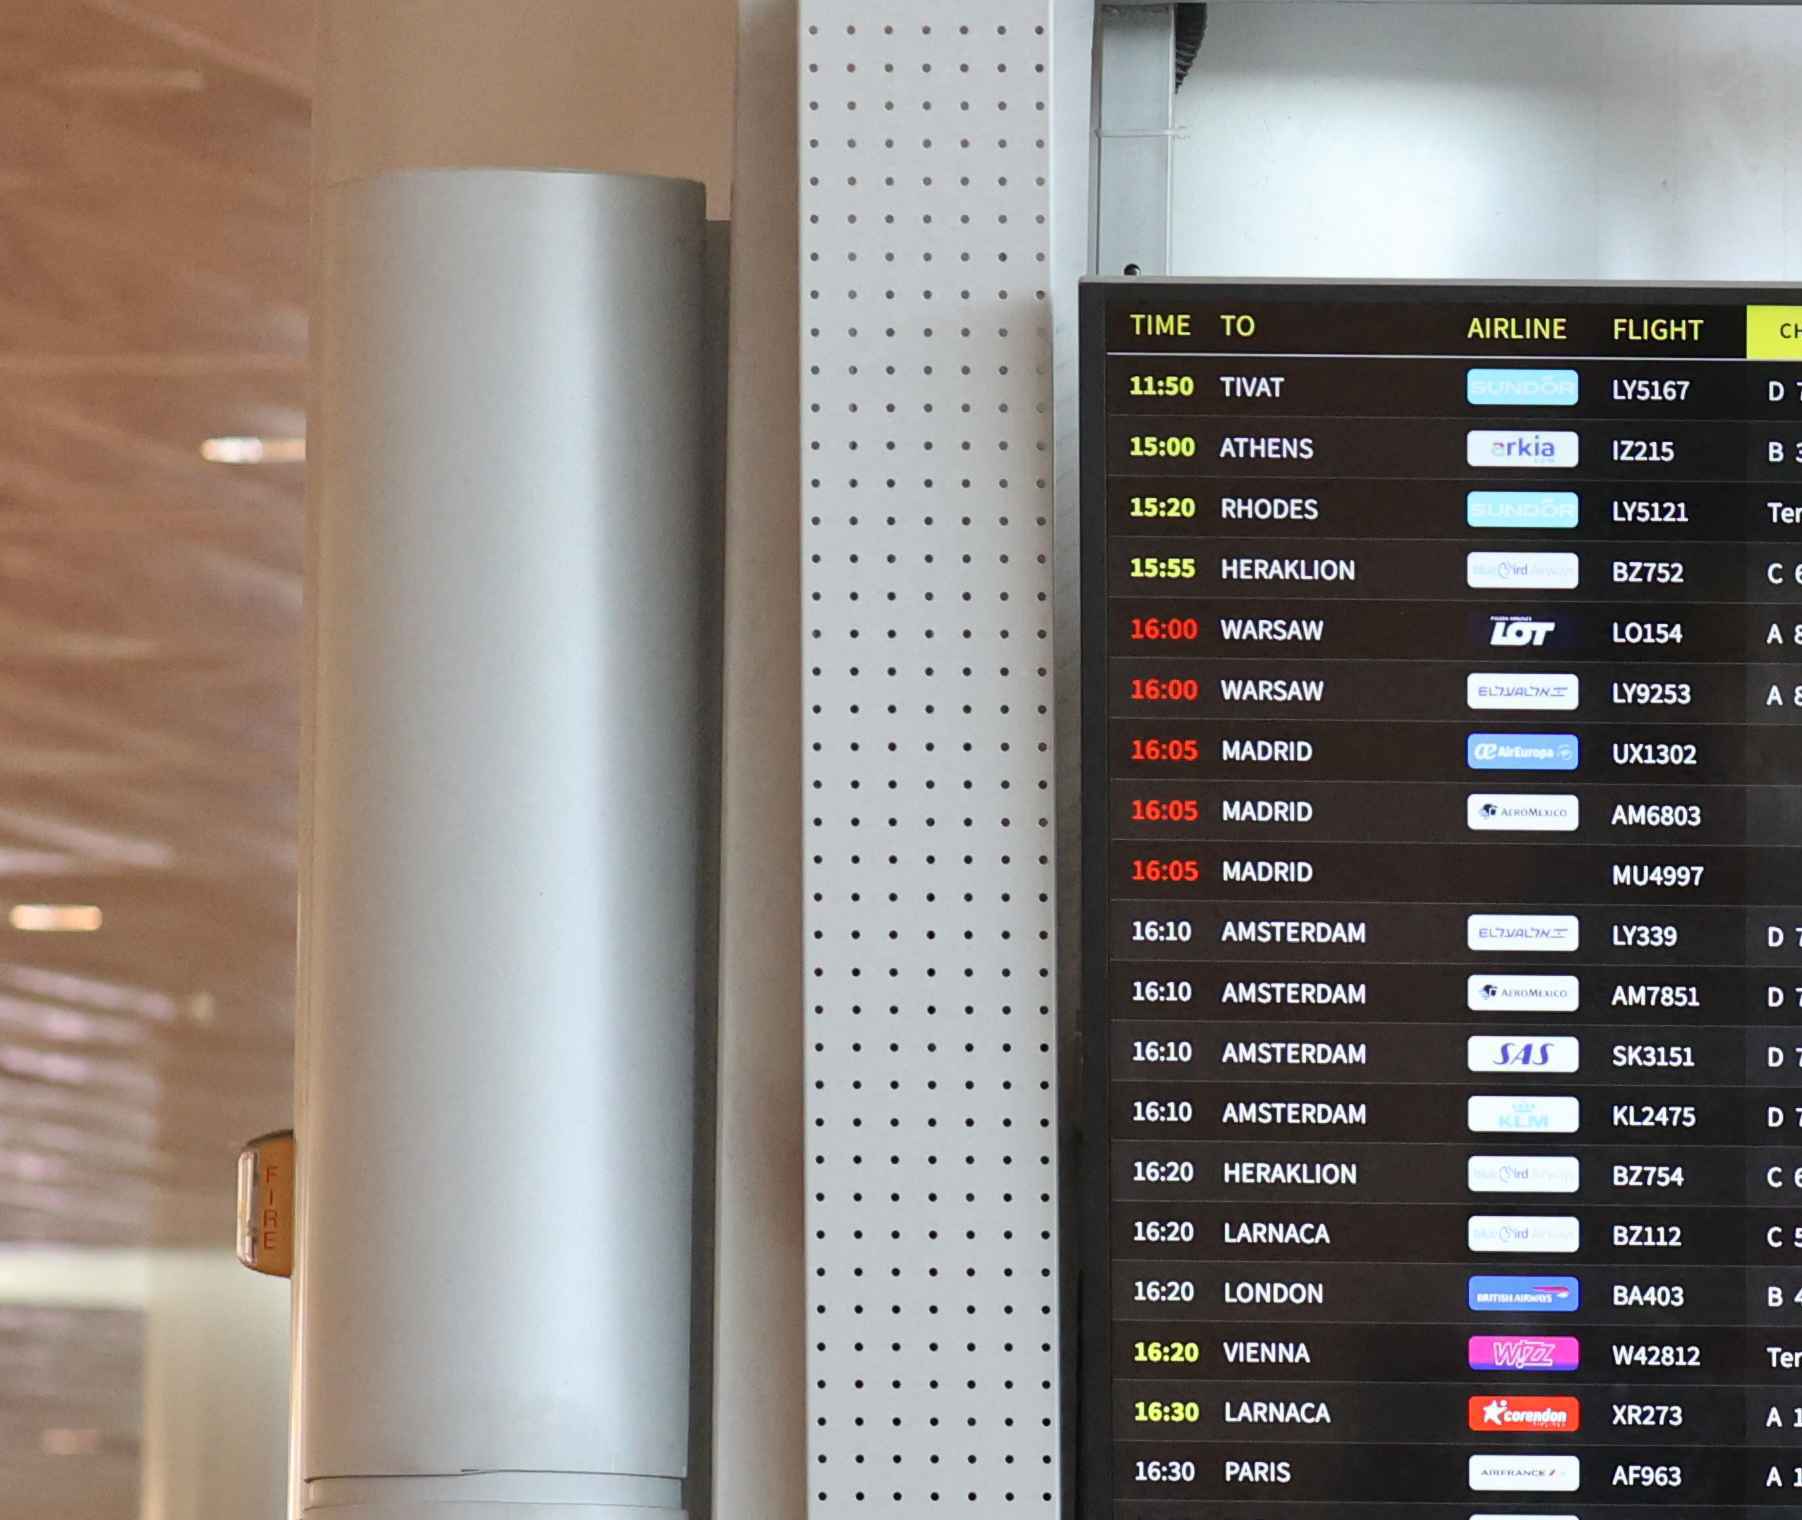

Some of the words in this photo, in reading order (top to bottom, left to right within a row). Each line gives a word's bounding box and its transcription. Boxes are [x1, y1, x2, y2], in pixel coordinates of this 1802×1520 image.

[1129, 314, 1191, 336] TIME
[1219, 314, 1255, 337] TO
[1467, 317, 1568, 340] AIRLINE
[1613, 318, 1705, 341] FLIGHT
[1129, 375, 1195, 397] 11:50
[1219, 376, 1285, 398] TIVAT
[1612, 379, 1691, 401] LY5167
[1768, 380, 1785, 402] D
[1129, 436, 1196, 458] 15:00
[1219, 436, 1314, 460] ATHENS
[1612, 439, 1675, 462] IZ215
[1768, 441, 1785, 463] B
[1130, 616, 1200, 641] 16:00
[1220, 619, 1325, 641] WARSAW
[1490, 621, 1556, 647] LOT
[1612, 621, 1683, 644] LO154
[1766, 623, 1784, 645] A
[1131, 738, 1201, 762] 16:05
[1222, 739, 1313, 762] MADRID
[1612, 743, 1697, 765] UX1302
[1132, 1040, 1193, 1063] 16:10
[1221, 1041, 1367, 1065] AMSTERDAM
[1493, 1042, 1554, 1065] SAS
[1612, 1044, 1696, 1068] SK3151
[1767, 1046, 1784, 1068] D
[1133, 1280, 1195, 1302] 16:20
[1224, 1281, 1324, 1305] LONDON
[1612, 1284, 1685, 1307] BA403
[1767, 1285, 1784, 1308] B
[1135, 1460, 1196, 1482] 16:30
[1225, 1460, 1292, 1484] PARIS
[1611, 1464, 1682, 1487] AF963
[1765, 1466, 1783, 1488] A
